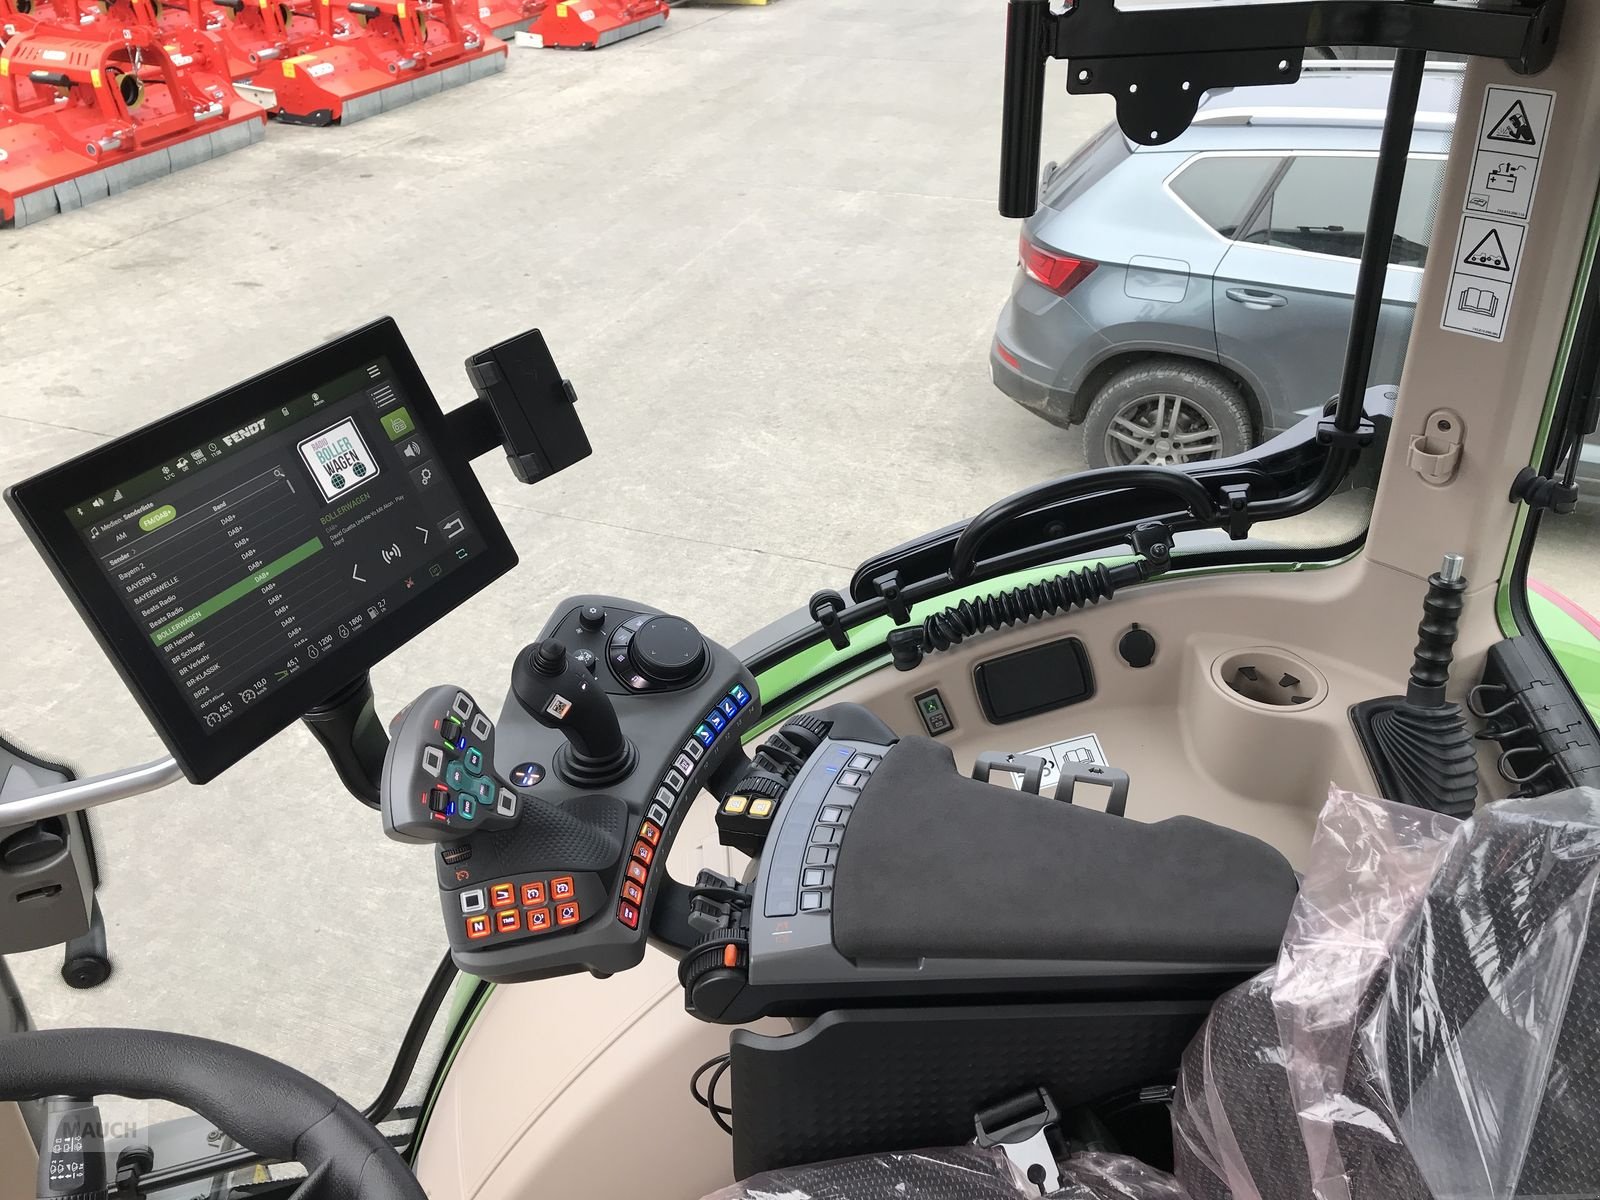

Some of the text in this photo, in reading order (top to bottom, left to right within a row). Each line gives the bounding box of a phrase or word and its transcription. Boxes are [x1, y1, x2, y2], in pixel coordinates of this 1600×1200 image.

[221, 417, 269, 448] FENDT
[310, 437, 328, 451] RADIO
[314, 435, 352, 464] BOLLER
[322, 448, 360, 477] WAGEN
[212, 500, 226, 511] Band
[319, 490, 371, 525] BOLLERWAGEN
[99, 500, 154, 532] Medien: Senderliste
[142, 508, 172, 527] FM/DAB+
[220, 512, 237, 525] DAB+
[329, 530, 342, 541] David
[341, 522, 356, 534] Guetta
[382, 499, 393, 509] Akon
[114, 531, 127, 542] AM
[227, 524, 243, 537] DAB+
[233, 535, 250, 548] DAB+
[332, 536, 345, 547] Hard
[108, 550, 131, 566] Sender
[240, 547, 257, 560] DAB+
[247, 558, 263, 571] DAB+
[254, 570, 270, 582] DAB+
[125, 574, 152, 593] BAYERN
[133, 575, 179, 605] BAYERNWELLE
[260, 581, 277, 594] DAB+
[141, 593, 177, 617] Beats Radio
[267, 592, 283, 605] DAB+
[148, 604, 184, 629] Beats Radio
[274, 603, 290, 616] DAB+
[156, 610, 202, 641] BOLLERWAGEN
[280, 614, 296, 627] DAB+
[347, 613, 363, 627] 1800
[287, 625, 302, 638] DAB+
[164, 630, 195, 653] BR Heimat
[317, 633, 333, 647] 1200
[171, 639, 207, 664] BR Schlager
[178, 652, 210, 676] BR Verkehr
[285, 656, 299, 669] 45,1
[185, 662, 221, 688] BR-KLASSIK
[252, 677, 267, 691] 10,0
[192, 685, 210, 699] BR24
[217, 700, 233, 714] 45,1
[474, 922, 484, 931] N
